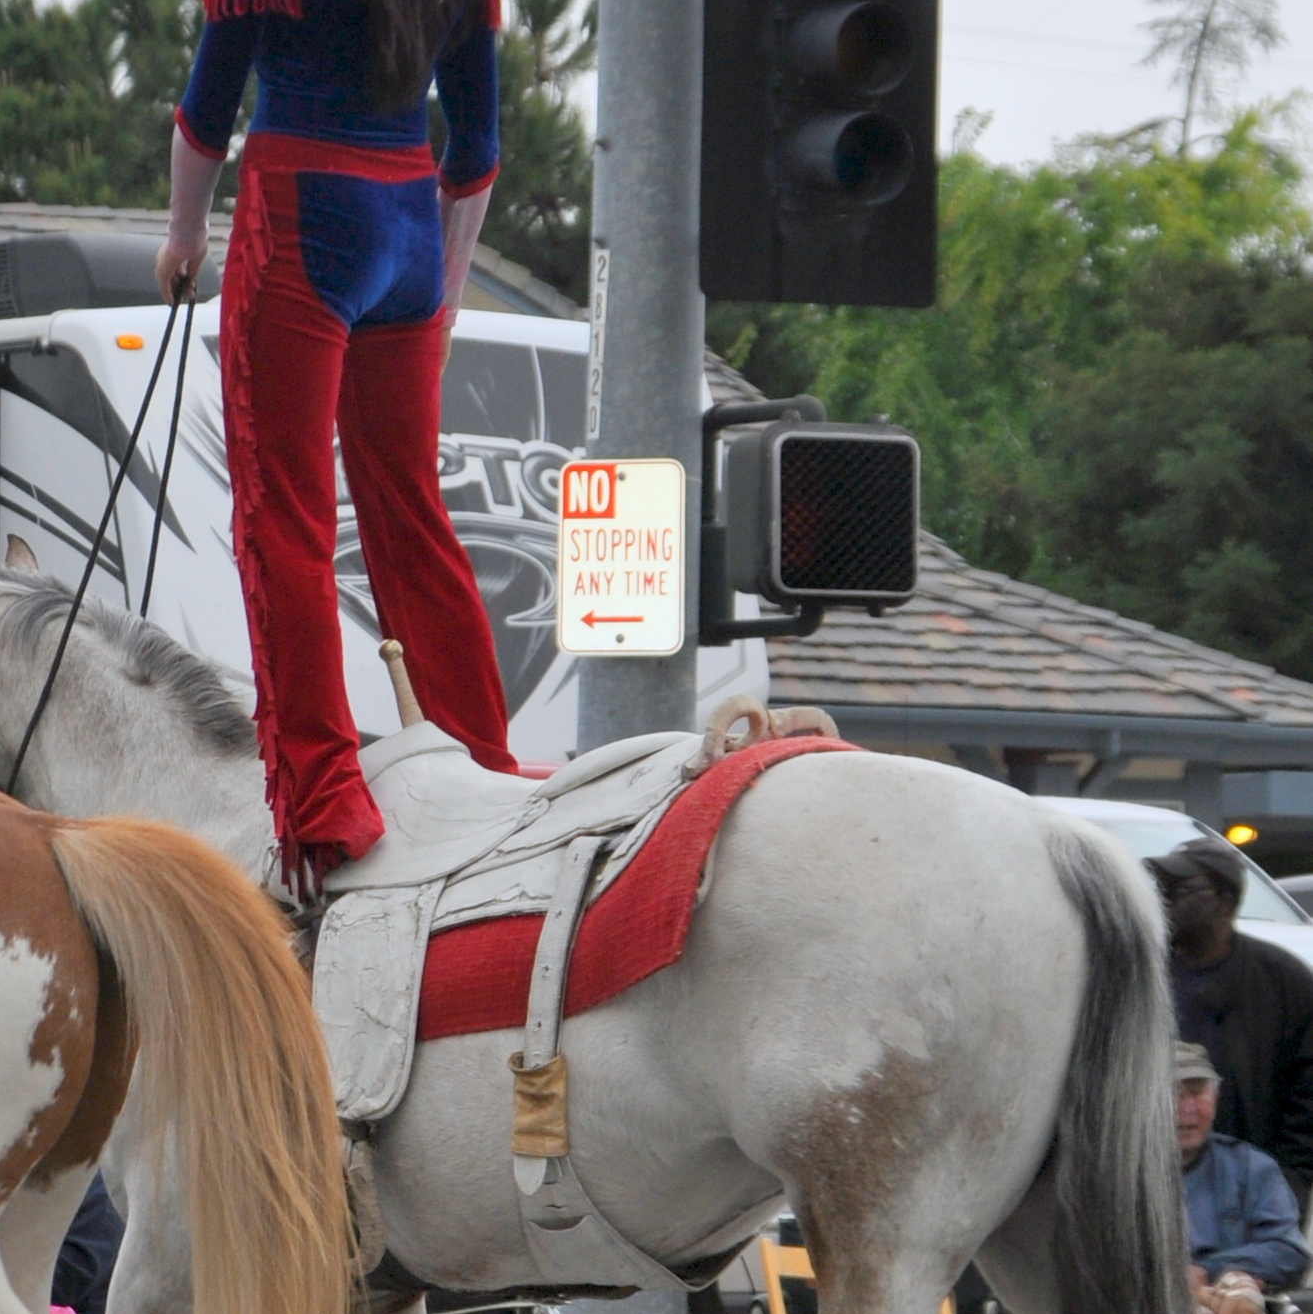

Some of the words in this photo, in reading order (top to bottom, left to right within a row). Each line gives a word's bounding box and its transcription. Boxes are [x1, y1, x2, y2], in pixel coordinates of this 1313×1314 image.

[569, 469, 611, 513] NO
[570, 528, 673, 562] STOPPING
[573, 571, 615, 596] ANY
[624, 571, 668, 596] TIME
